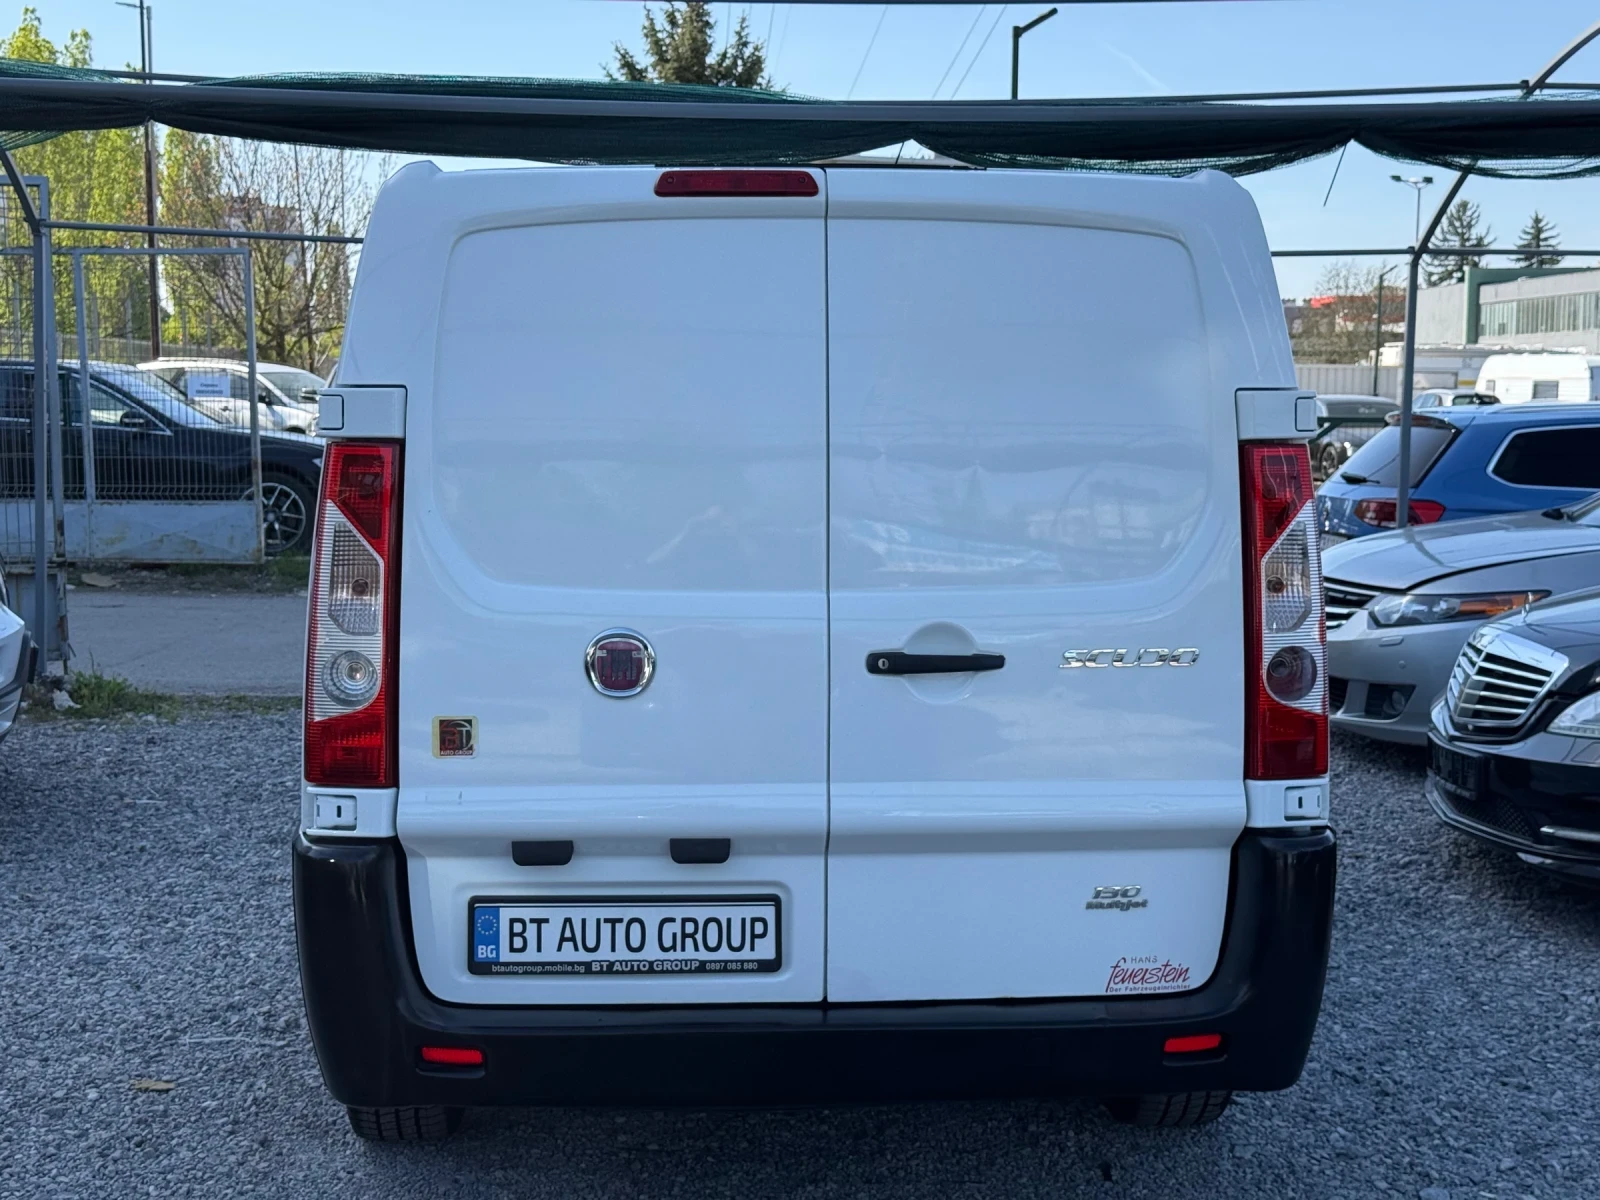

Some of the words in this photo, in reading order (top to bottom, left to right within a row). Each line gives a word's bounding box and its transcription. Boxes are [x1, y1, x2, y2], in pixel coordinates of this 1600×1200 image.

[1058, 647, 1200, 668] SCUDO
[1092, 885, 1141, 899] 130
[508, 917, 550, 953] BT
[556, 917, 647, 953] AUTO
[657, 917, 769, 952] GROUP
[477, 945, 497, 958] BG
[491, 964, 585, 973] btautogroup.mobile.bg
[591, 961, 609, 972] BT
[612, 961, 650, 972] AUTO
[653, 960, 700, 971] GROUP
[705, 962, 725, 970] 0897
[727, 962, 742, 970] 085
[1130, 955, 1158, 964] HANS
[1105, 957, 1190, 993] feuerstein
